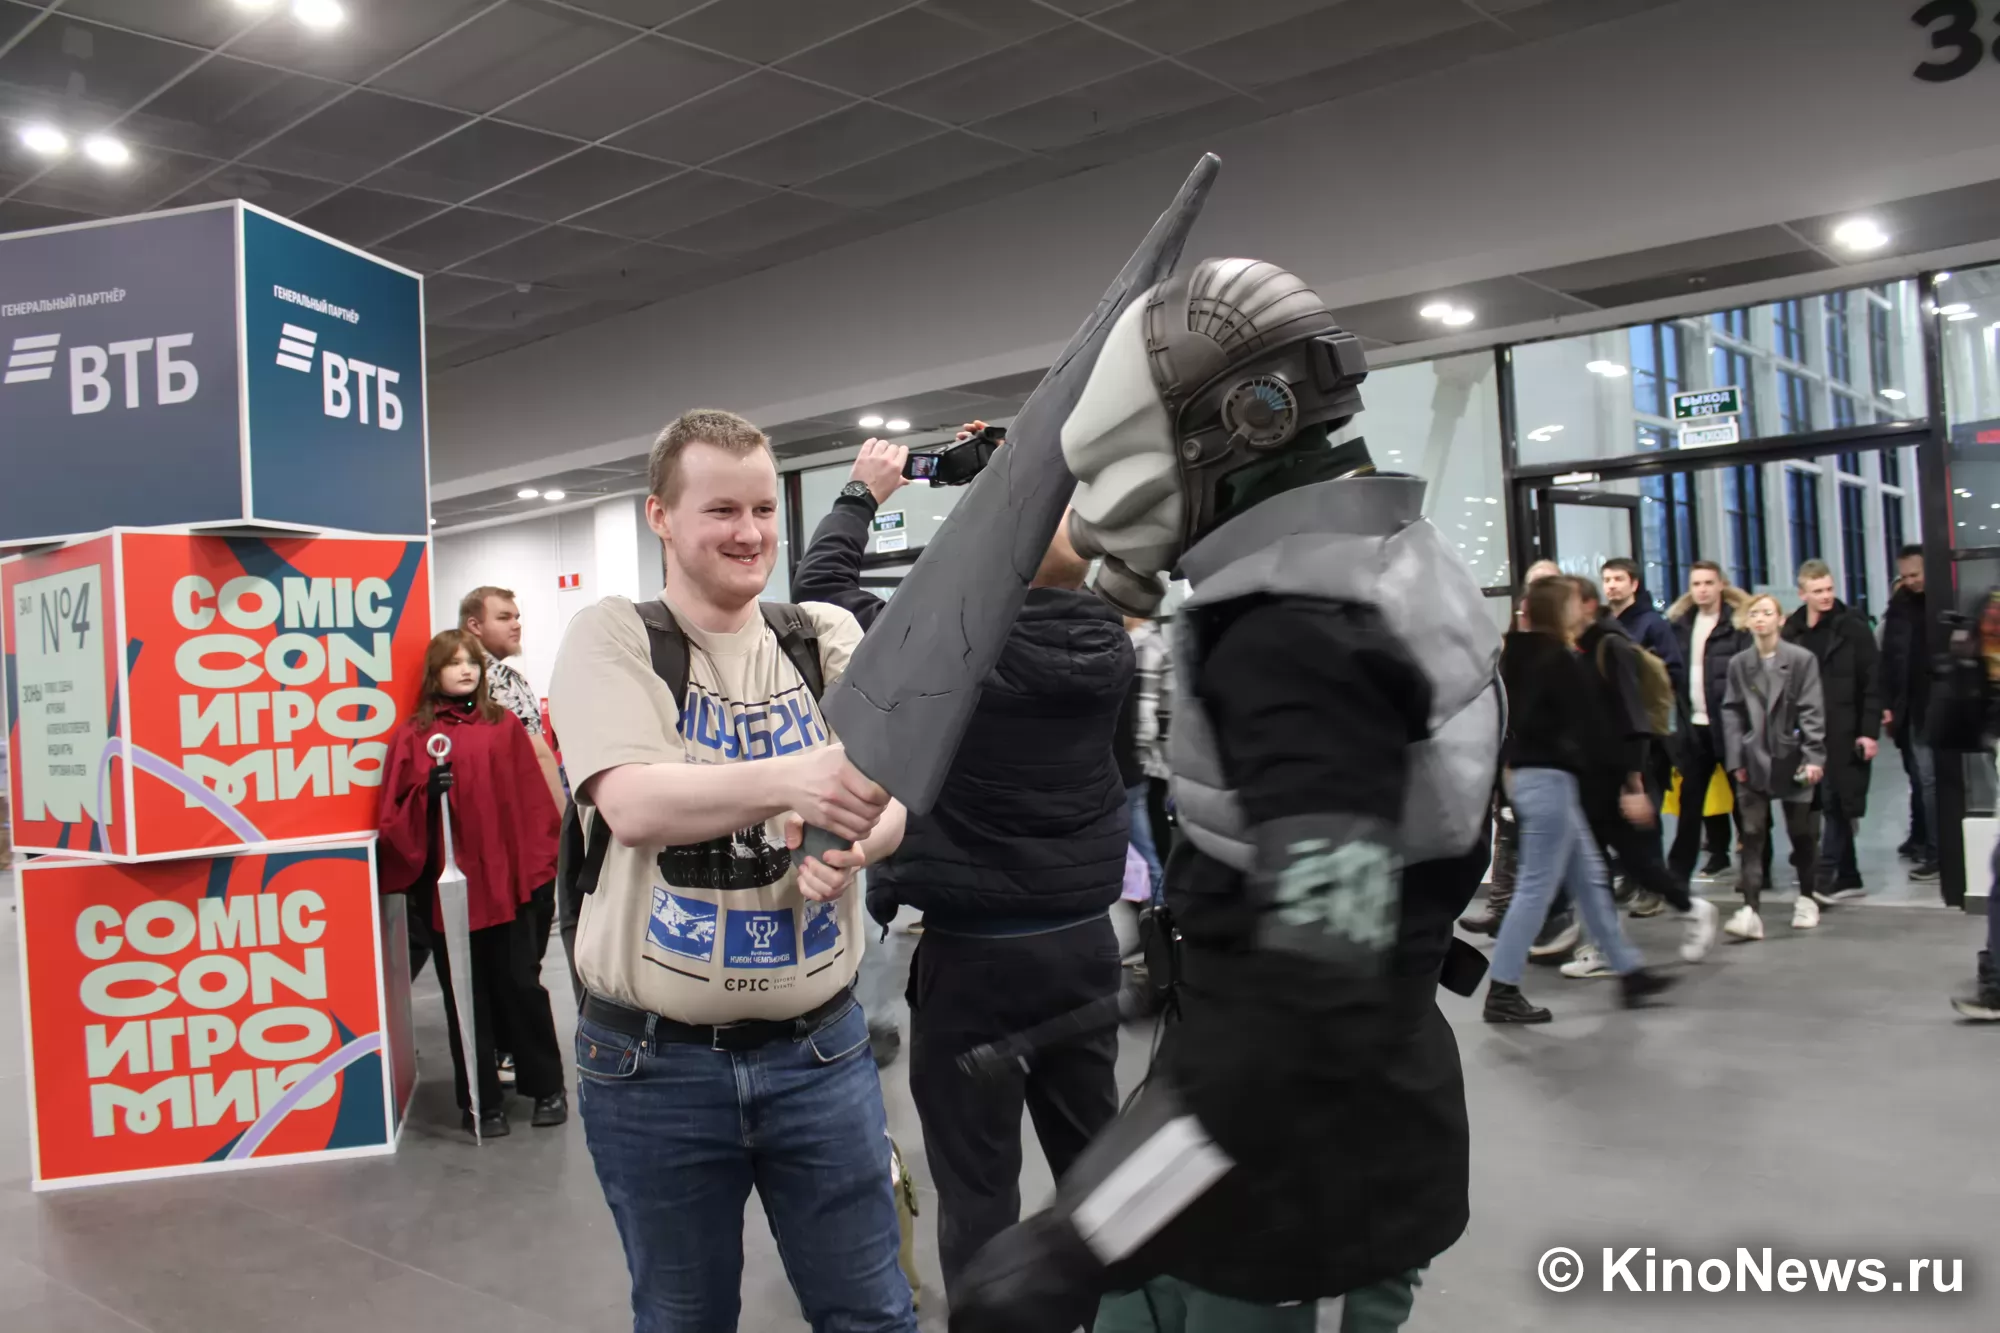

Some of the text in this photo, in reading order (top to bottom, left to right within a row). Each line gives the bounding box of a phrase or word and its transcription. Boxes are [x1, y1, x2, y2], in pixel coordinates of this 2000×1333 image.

[1, 287, 126, 317] ГЕНЕРАЛЬНЫЙ ПАРТНЁР
[273, 284, 360, 325] ГЕНЕРАЛЬНЫЙ ПАРТНЁР
[69, 332, 199, 415] ВТБ
[322, 350, 403, 431] ВТБ
[1680, 391, 1730, 407] ВЫХОД
[1691, 403, 1721, 416] EXIT
[172, 575, 393, 630] COMIC
[174, 632, 393, 689] CON
[179, 687, 397, 748] ИГРО
[75, 890, 327, 960] COMIC
[79, 947, 327, 1017] CON
[85, 1006, 333, 1078] ИГРО
